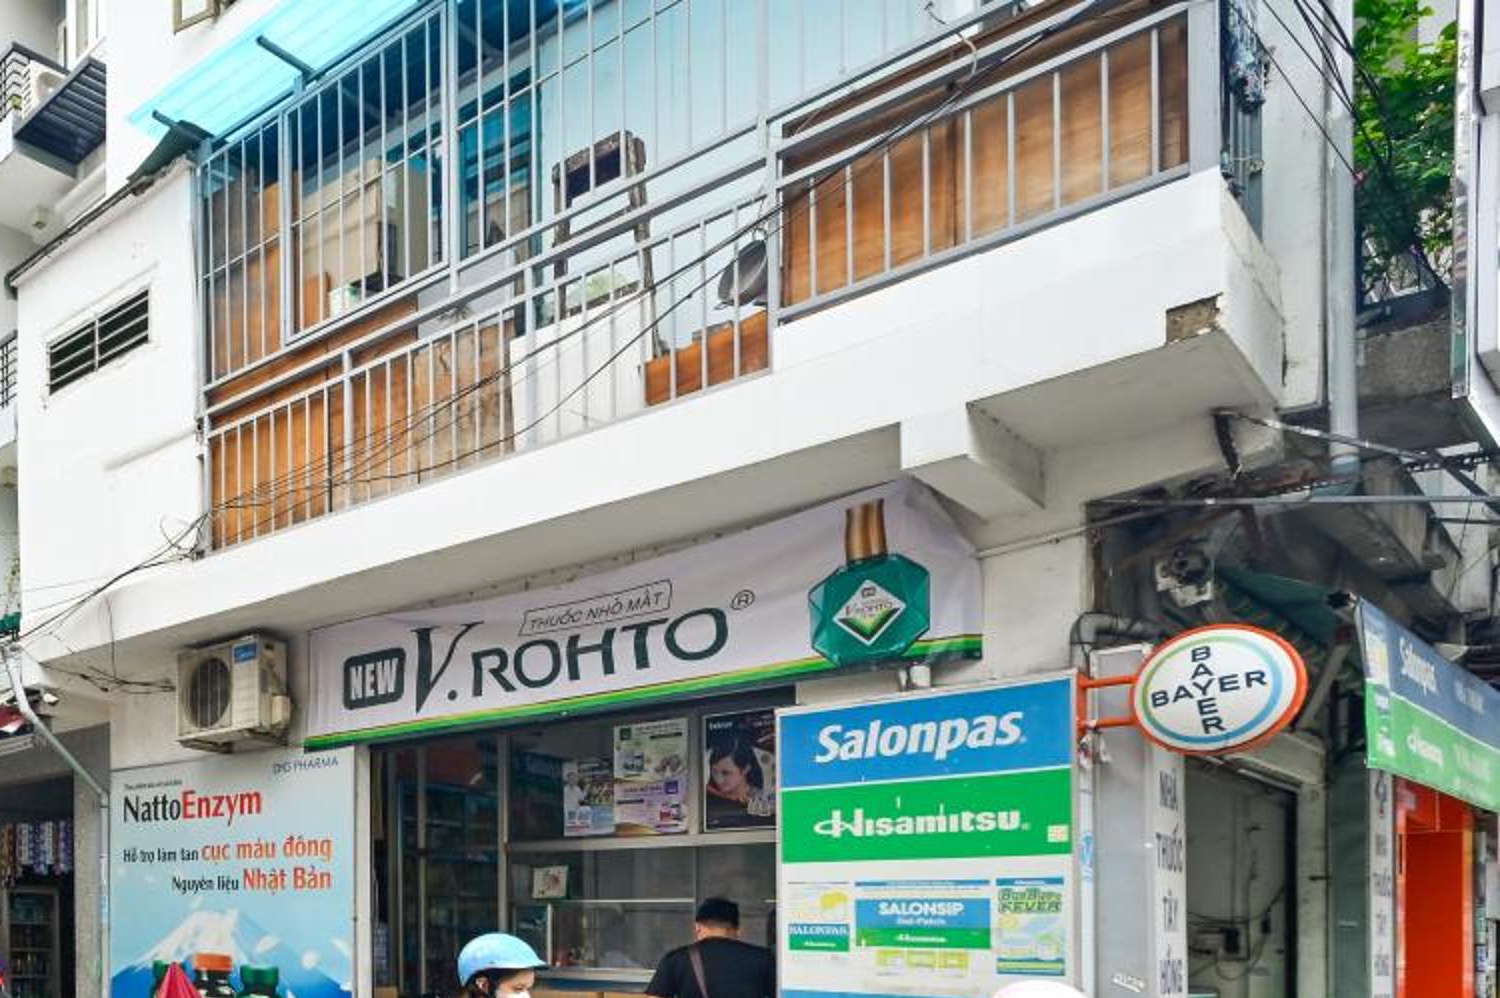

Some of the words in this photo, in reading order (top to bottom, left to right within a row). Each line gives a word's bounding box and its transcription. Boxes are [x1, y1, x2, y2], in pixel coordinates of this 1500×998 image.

[530, 608, 583, 631] THUỐC
[586, 598, 623, 621] NHỎ
[349, 657, 399, 701] NEW
[1151, 670, 1267, 709] BAYER
[1191, 646, 1226, 734] BAYER
[815, 711, 1024, 763] Salonpas
[293, 757, 339, 772] PHARMA
[123, 790, 262, 827] NattoEnzym
[181, 847, 199, 862] tan
[202, 843, 230, 865] cục
[236, 837, 276, 860] máu
[283, 834, 333, 864] đông
[243, 868, 287, 896] Nhật
[293, 864, 332, 890] Bản
